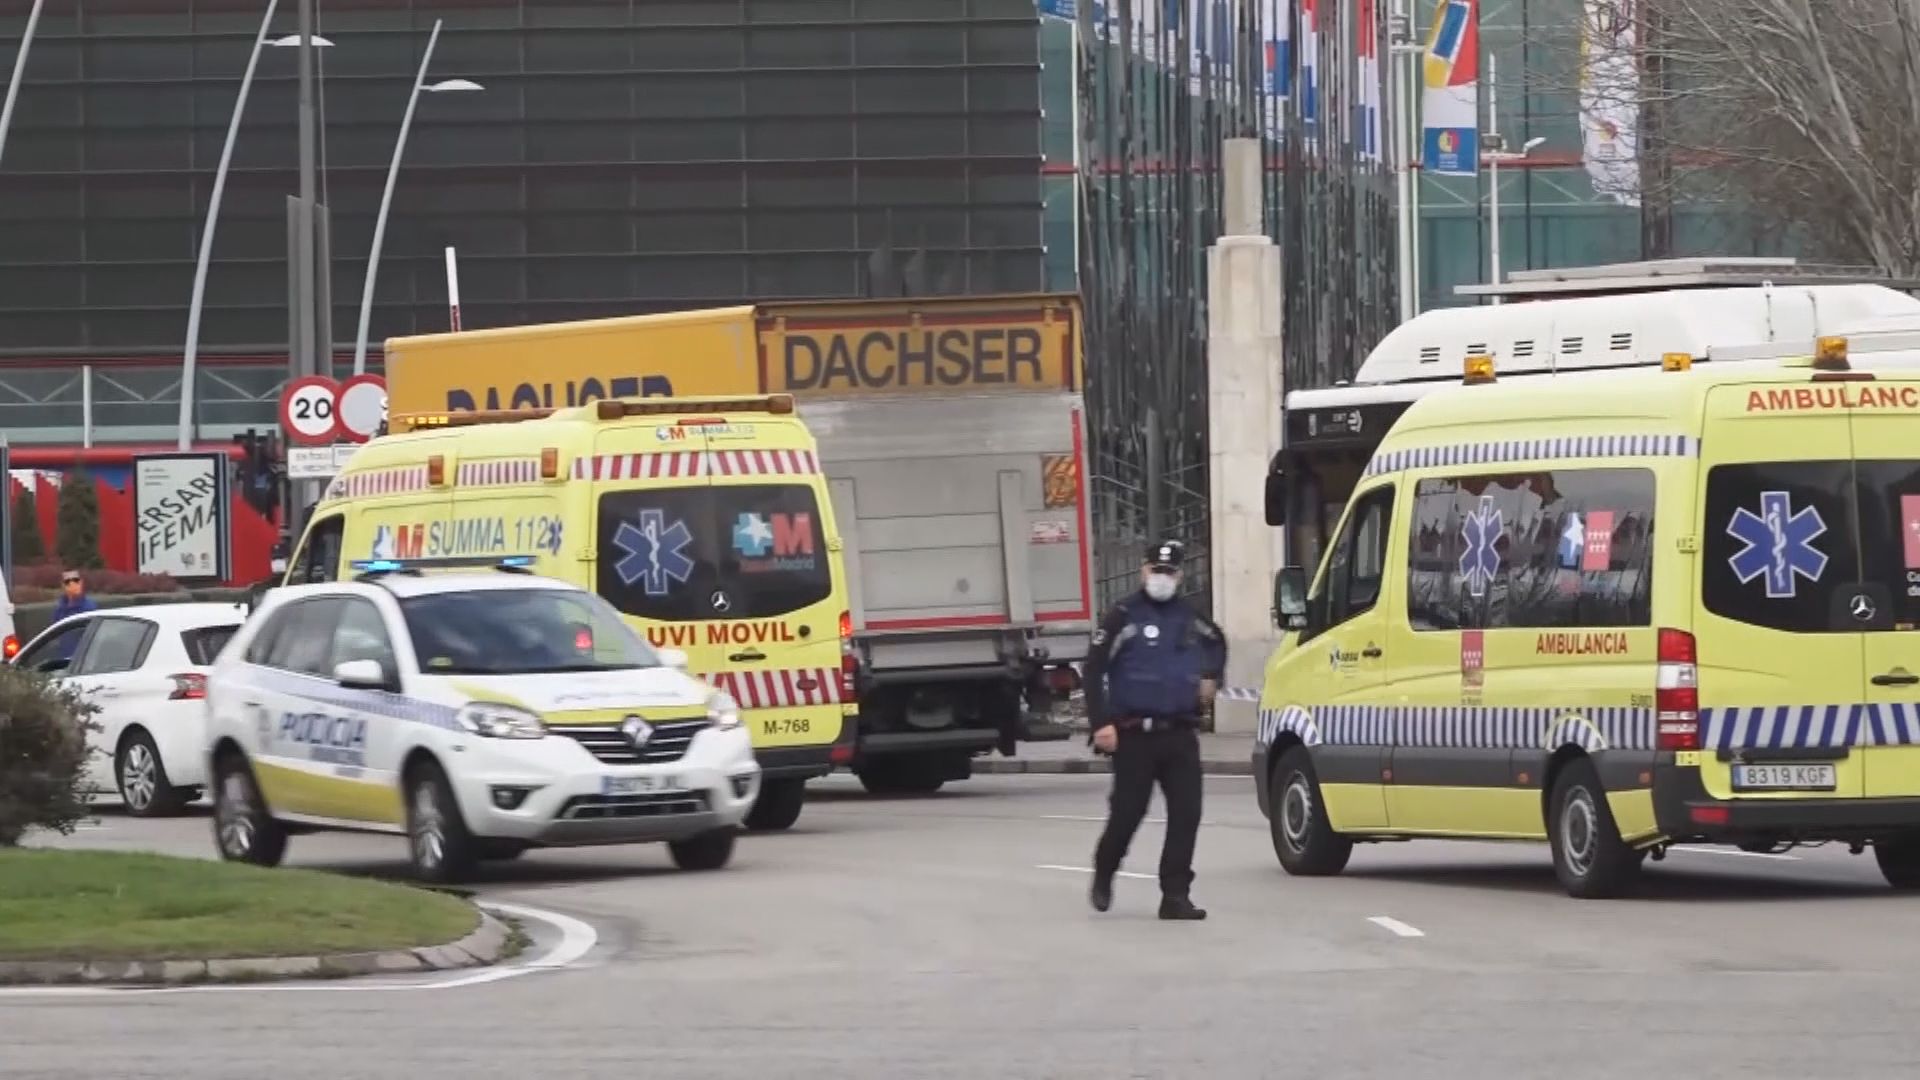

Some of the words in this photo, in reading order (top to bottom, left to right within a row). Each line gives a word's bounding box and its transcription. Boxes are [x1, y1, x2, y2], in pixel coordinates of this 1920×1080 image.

[784, 328, 1042, 390] DACHSER
[295, 397, 332, 419] 20
[1746, 387, 1919, 412] AMBULANC
[428, 517, 505, 556] SUMMA
[514, 516, 550, 550] 112
[647, 625, 696, 647] UVI
[707, 621, 795, 645] MOVIL
[1536, 632, 1628, 654] AMBULANCIA
[763, 718, 810, 735] M-768
[1747, 767, 1791, 784] 8319
[1795, 767, 1828, 783] KGF
